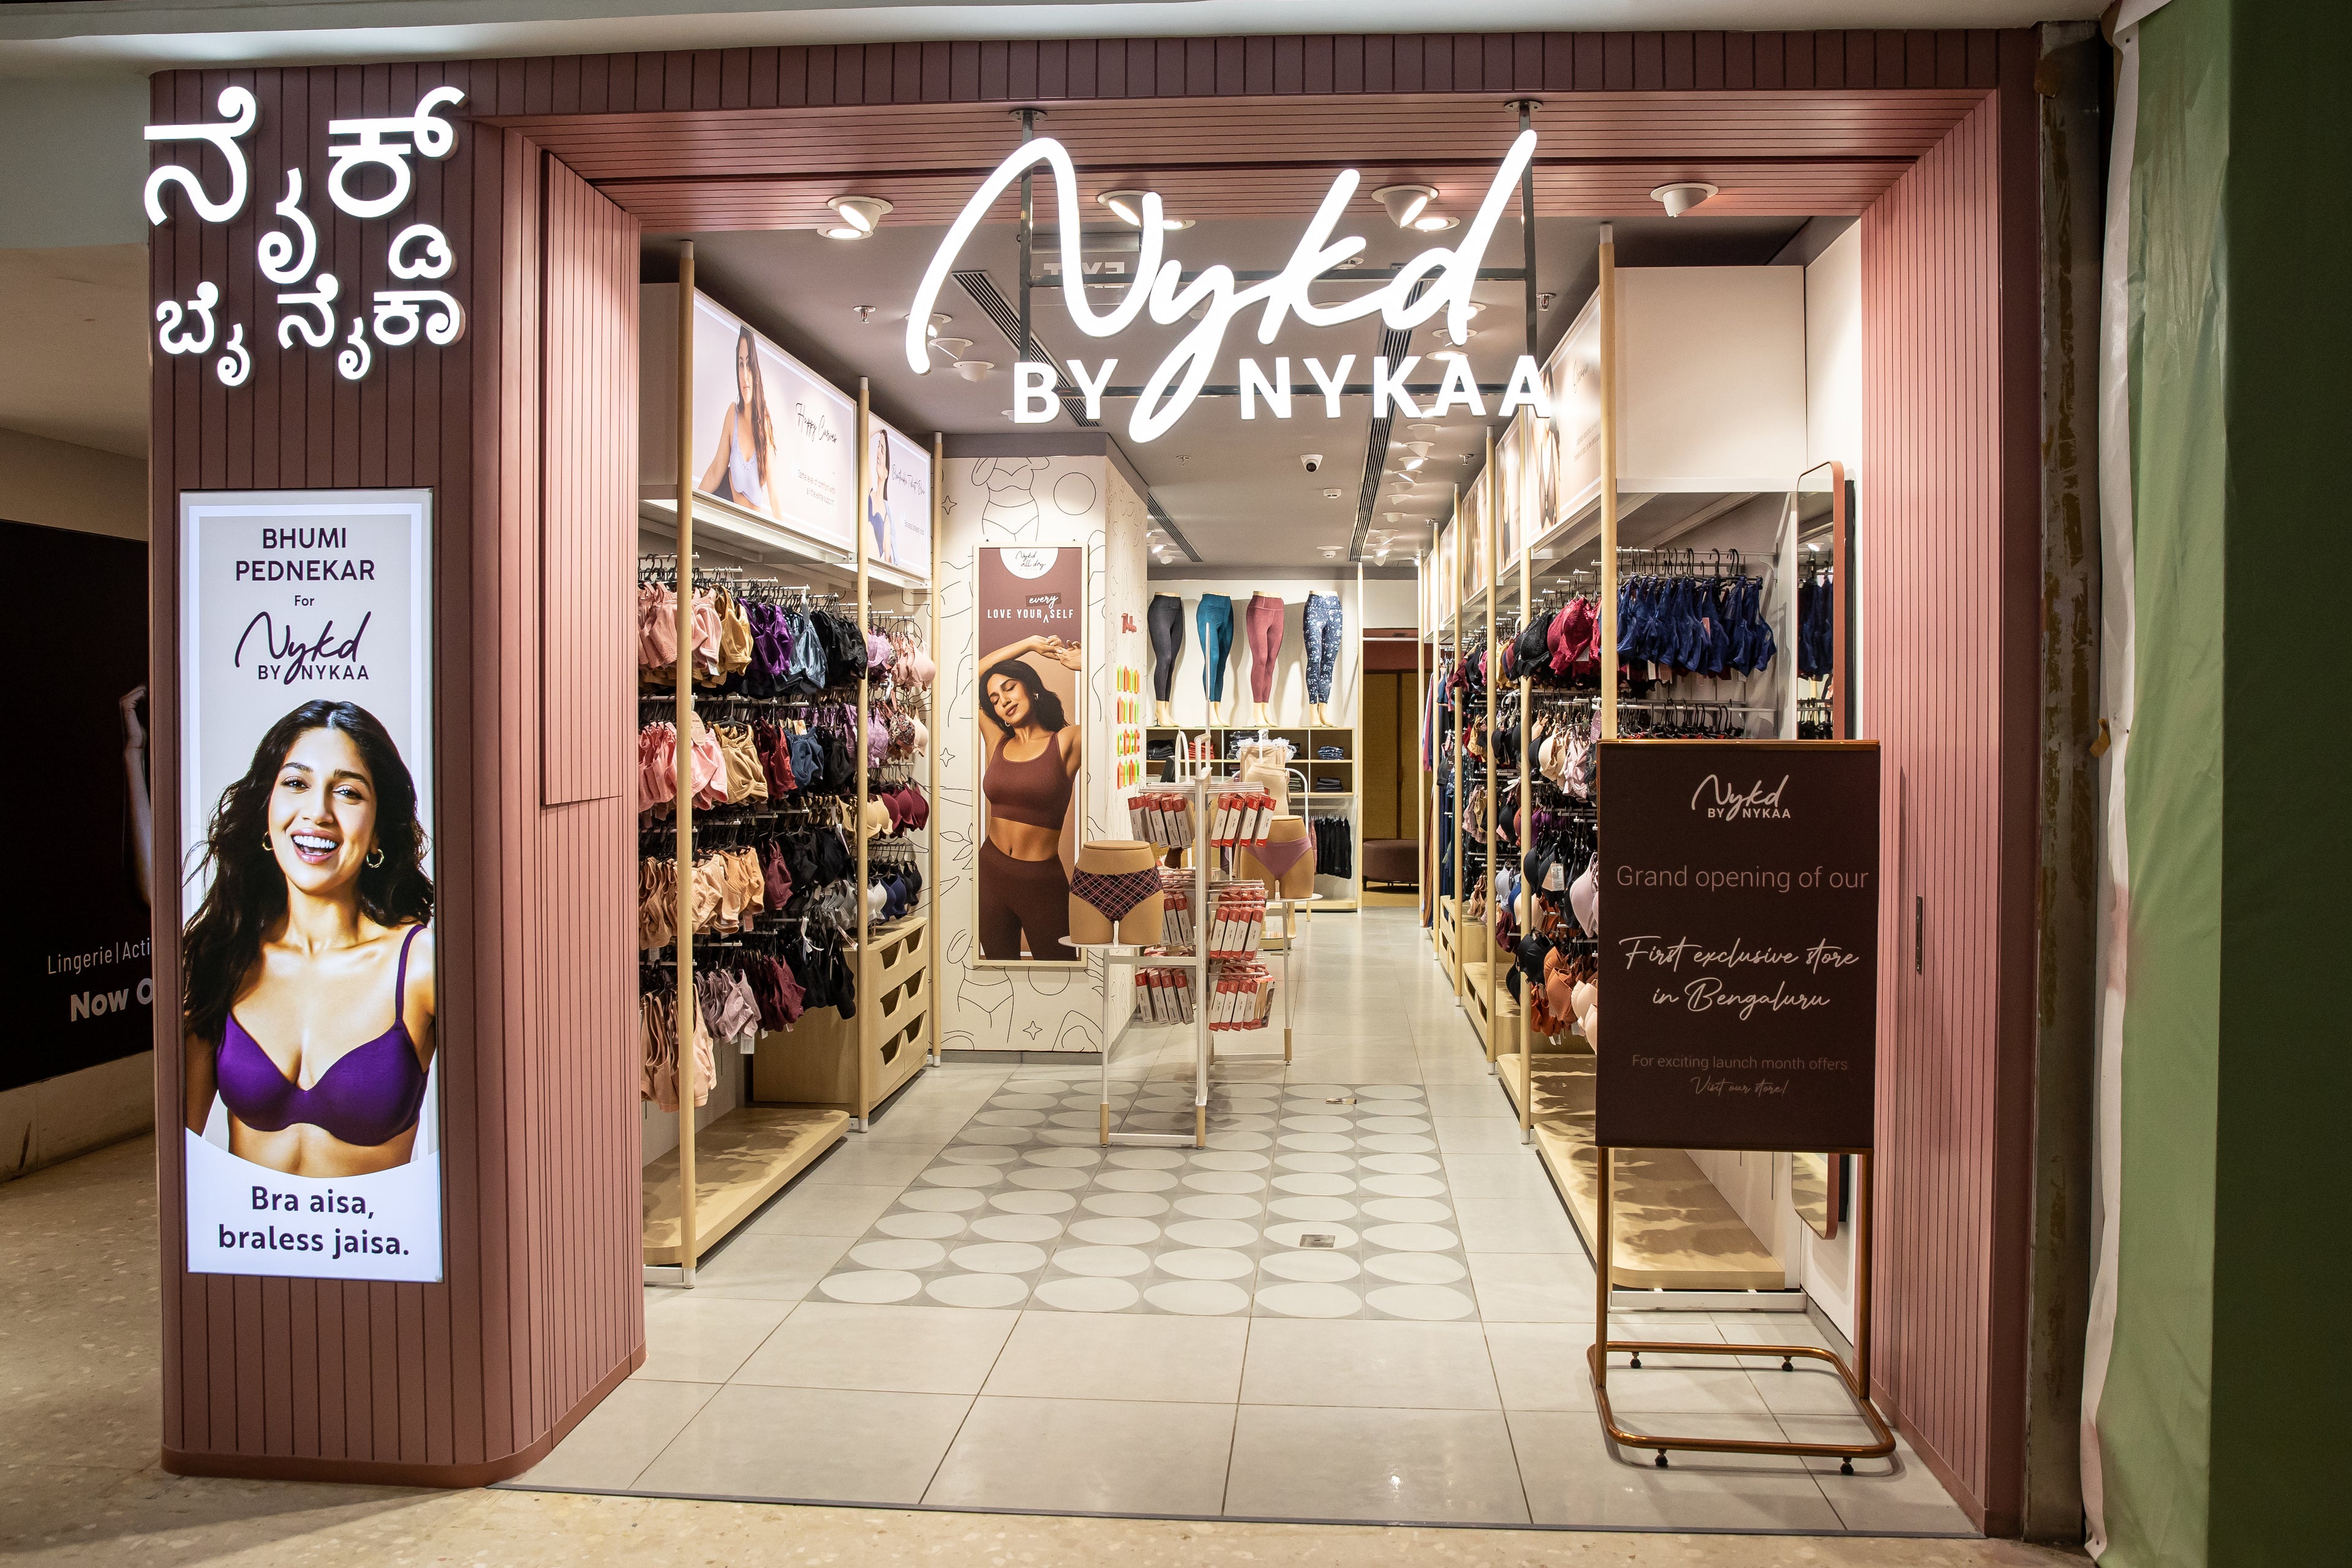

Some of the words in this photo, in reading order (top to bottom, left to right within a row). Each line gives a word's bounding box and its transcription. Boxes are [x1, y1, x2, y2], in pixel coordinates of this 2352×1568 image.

[905, 130, 1537, 443] Nykd
[156, 281, 251, 386] ಬೈ
[277, 273, 461, 380] ನೈಕಾ
[1014, 359, 1118, 424] BY
[1240, 355, 1551, 420] NYKAA
[262, 527, 347, 549] BHUMI
[235, 559, 375, 581] PEDNEKAR
[294, 595, 315, 606] For
[987, 609, 1011, 619] LOVE
[1017, 609, 1042, 619] YOUR
[1050, 609, 1074, 619] SELF
[1028, 595, 1059, 609] every
[234, 611, 372, 685] Nykd
[258, 665, 281, 680] BY
[301, 665, 369, 680] NYKAA
[1691, 774, 1789, 821] Nykd
[1708, 808, 1724, 818] BY
[1742, 808, 1791, 818] NYKAA
[1616, 865, 1687, 887] Grand
[1695, 865, 1790, 893] opening
[1798, 866, 1823, 888] of
[1829, 871, 1869, 888] our
[48, 946, 112, 974] Lingerie
[1618, 935, 1703, 972] First
[1693, 937, 1799, 968] exclusive
[1806, 937, 1860, 974] store
[70, 988, 129, 1022] Now
[1653, 987, 1679, 1004] in
[1684, 977, 1830, 1020] Bengaluru
[1632, 1054, 1654, 1066] For
[1657, 1055, 1708, 1071] exciting
[1713, 1055, 1757, 1068] launch
[1762, 1057, 1804, 1070] month
[1809, 1057, 1848, 1071] offers
[1690, 1075, 1735, 1097] Visit
[1728, 1085, 1751, 1094] our
[1754, 1079, 1790, 1097] store!
[252, 1185, 299, 1212] Bra
[309, 1188, 374, 1219] aisa,
[219, 1223, 323, 1252] braless
[331, 1227, 410, 1260] jaisa.
